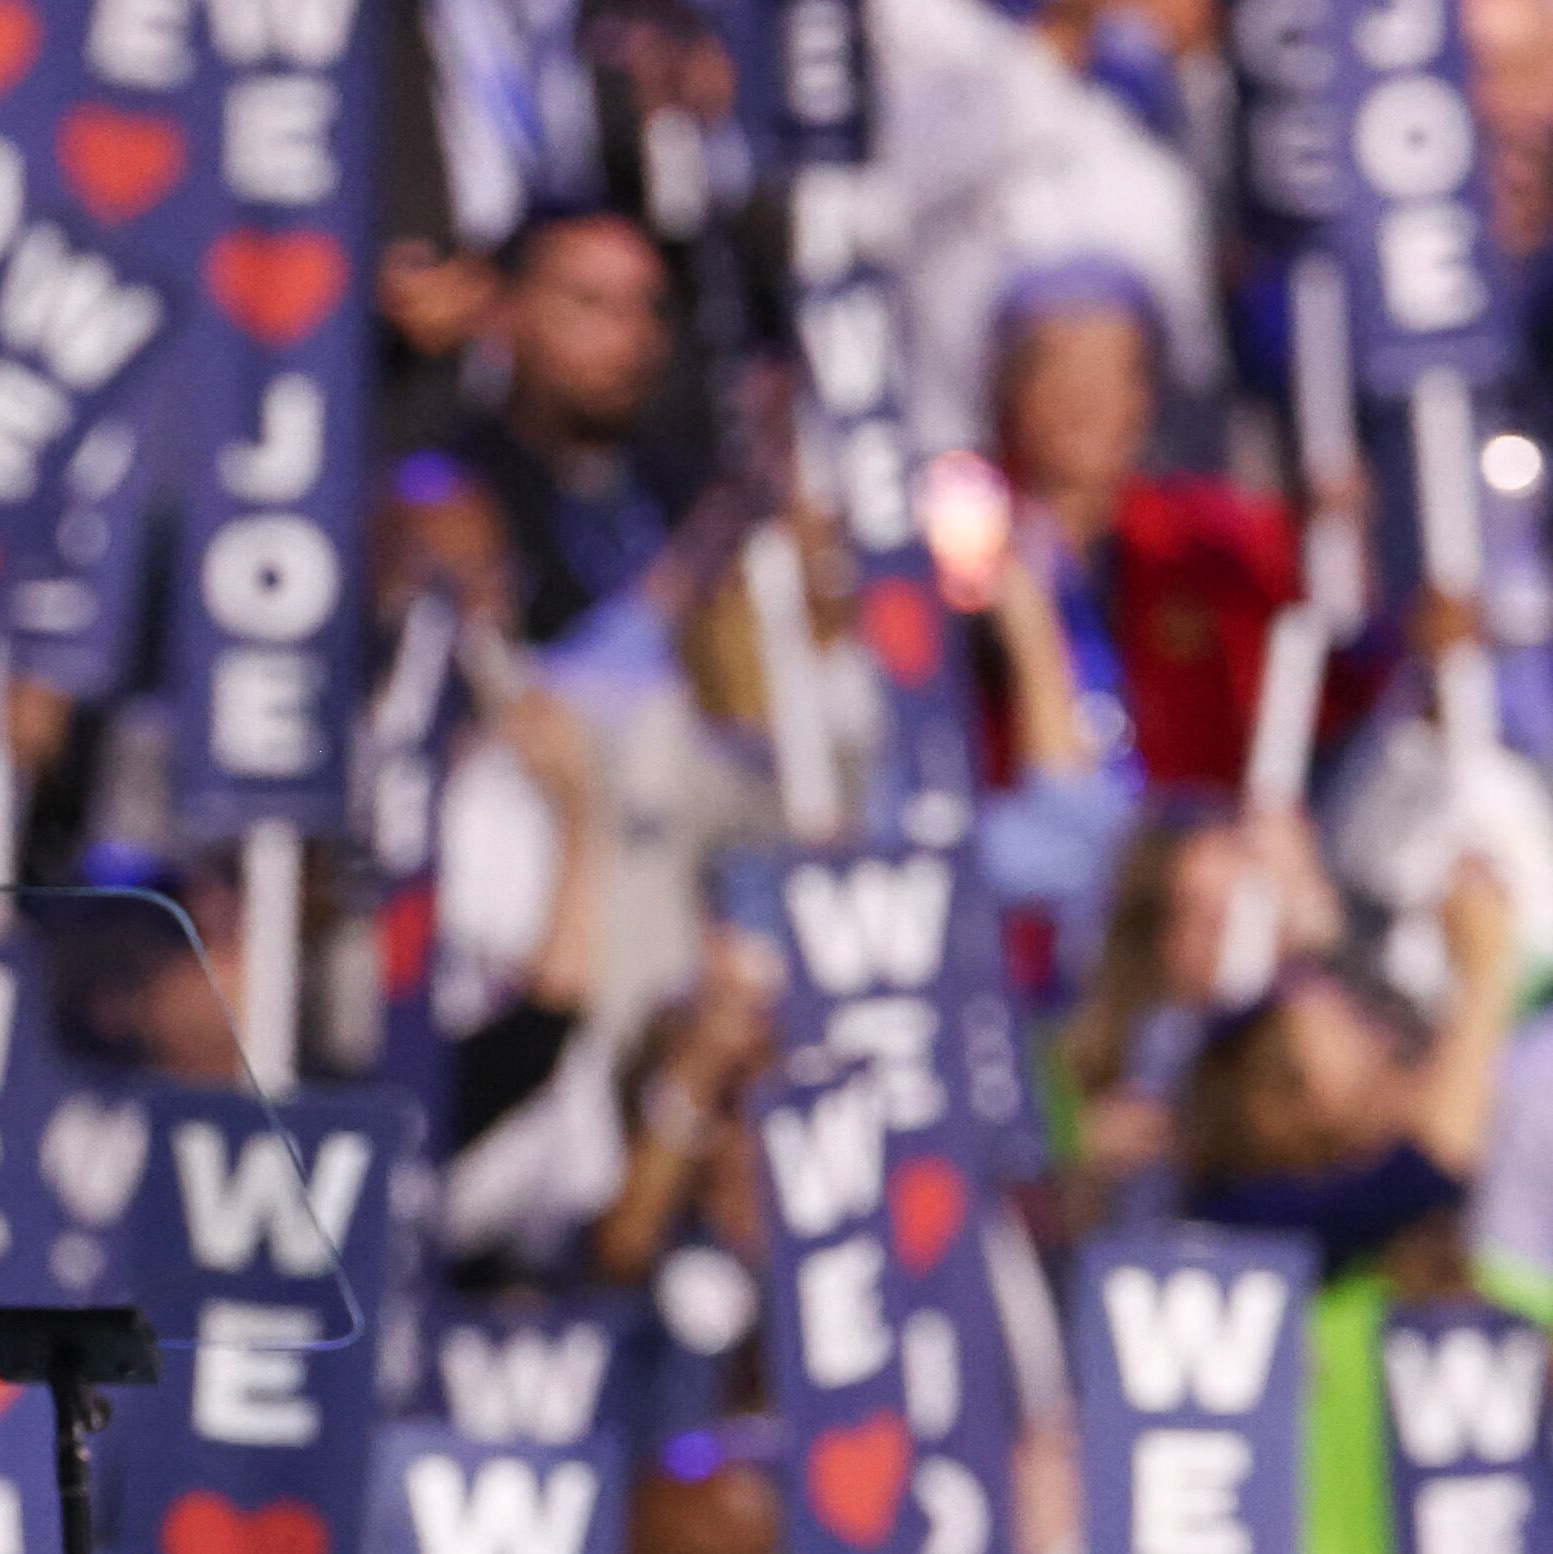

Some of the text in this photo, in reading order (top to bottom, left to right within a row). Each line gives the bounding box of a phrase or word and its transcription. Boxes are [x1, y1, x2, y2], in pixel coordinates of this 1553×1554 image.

[200, 370, 342, 780] JOE
[171, 1117, 375, 1449] WE
[762, 1073, 893, 1390] WE
